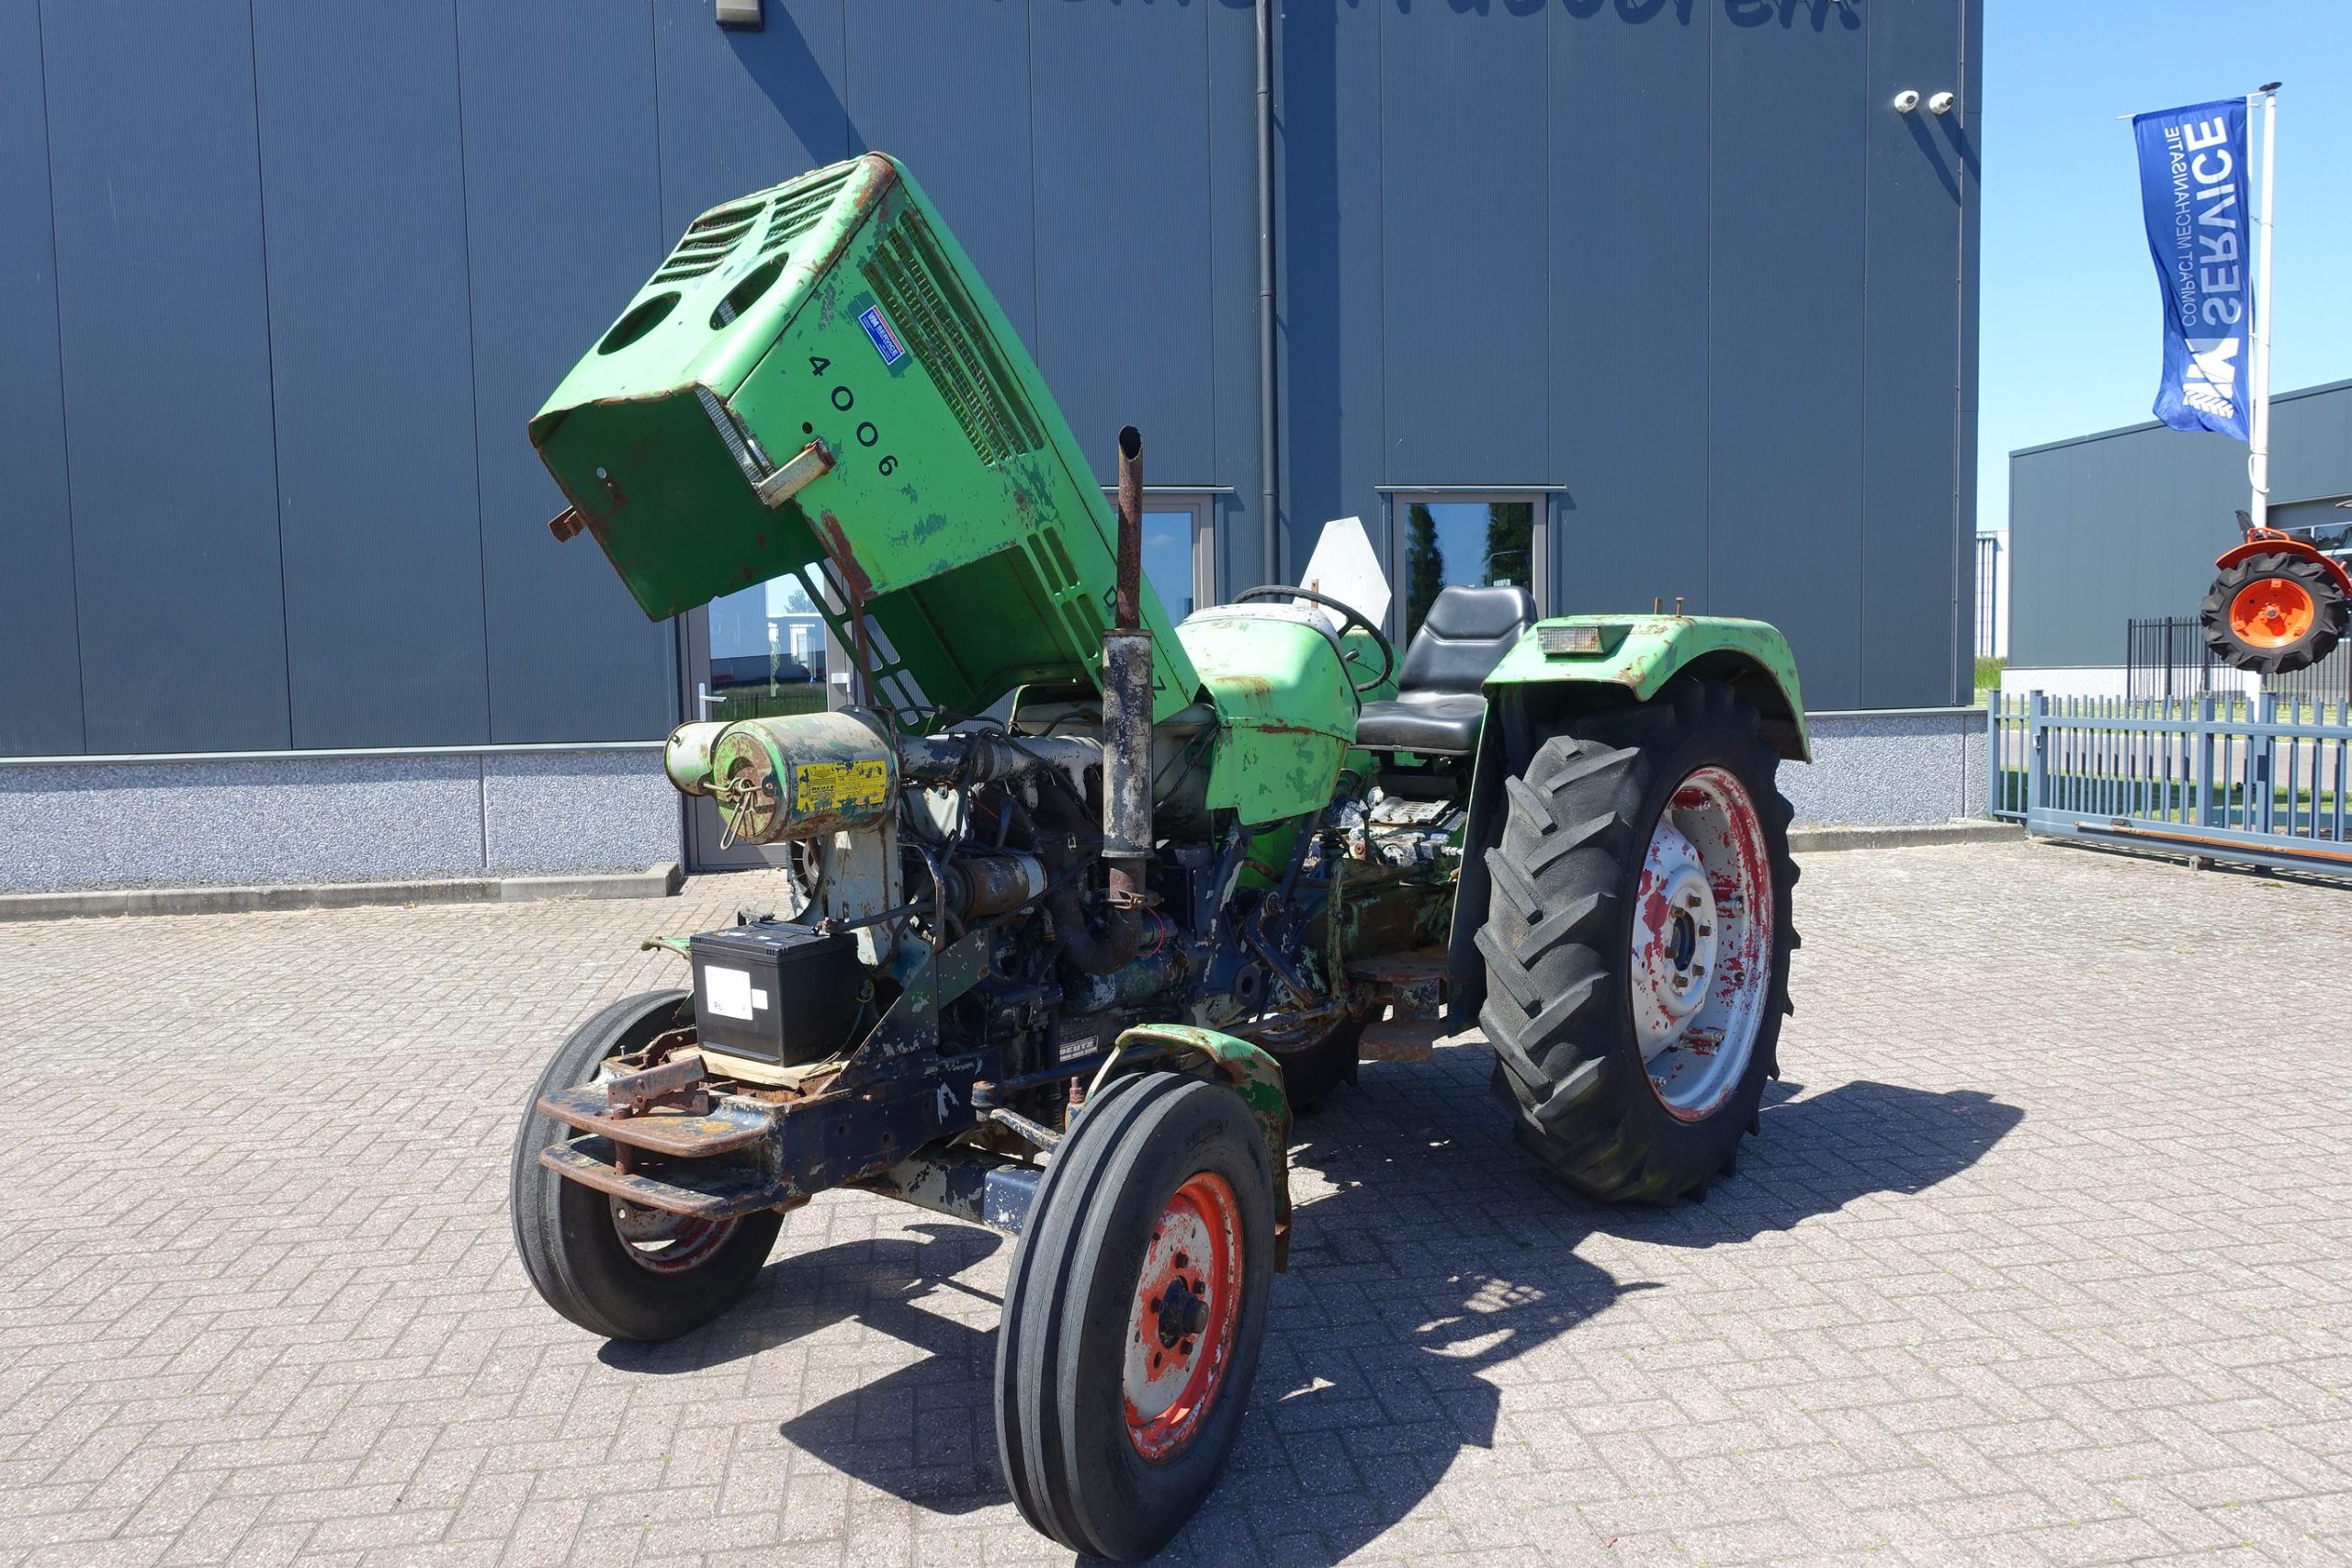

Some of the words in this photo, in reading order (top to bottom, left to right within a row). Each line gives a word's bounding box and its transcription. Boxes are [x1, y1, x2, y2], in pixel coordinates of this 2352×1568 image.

[876, 324, 899, 355] SERVICE
[808, 356, 899, 476] 4006
[1059, 1040, 1094, 1056] DEUTZ
